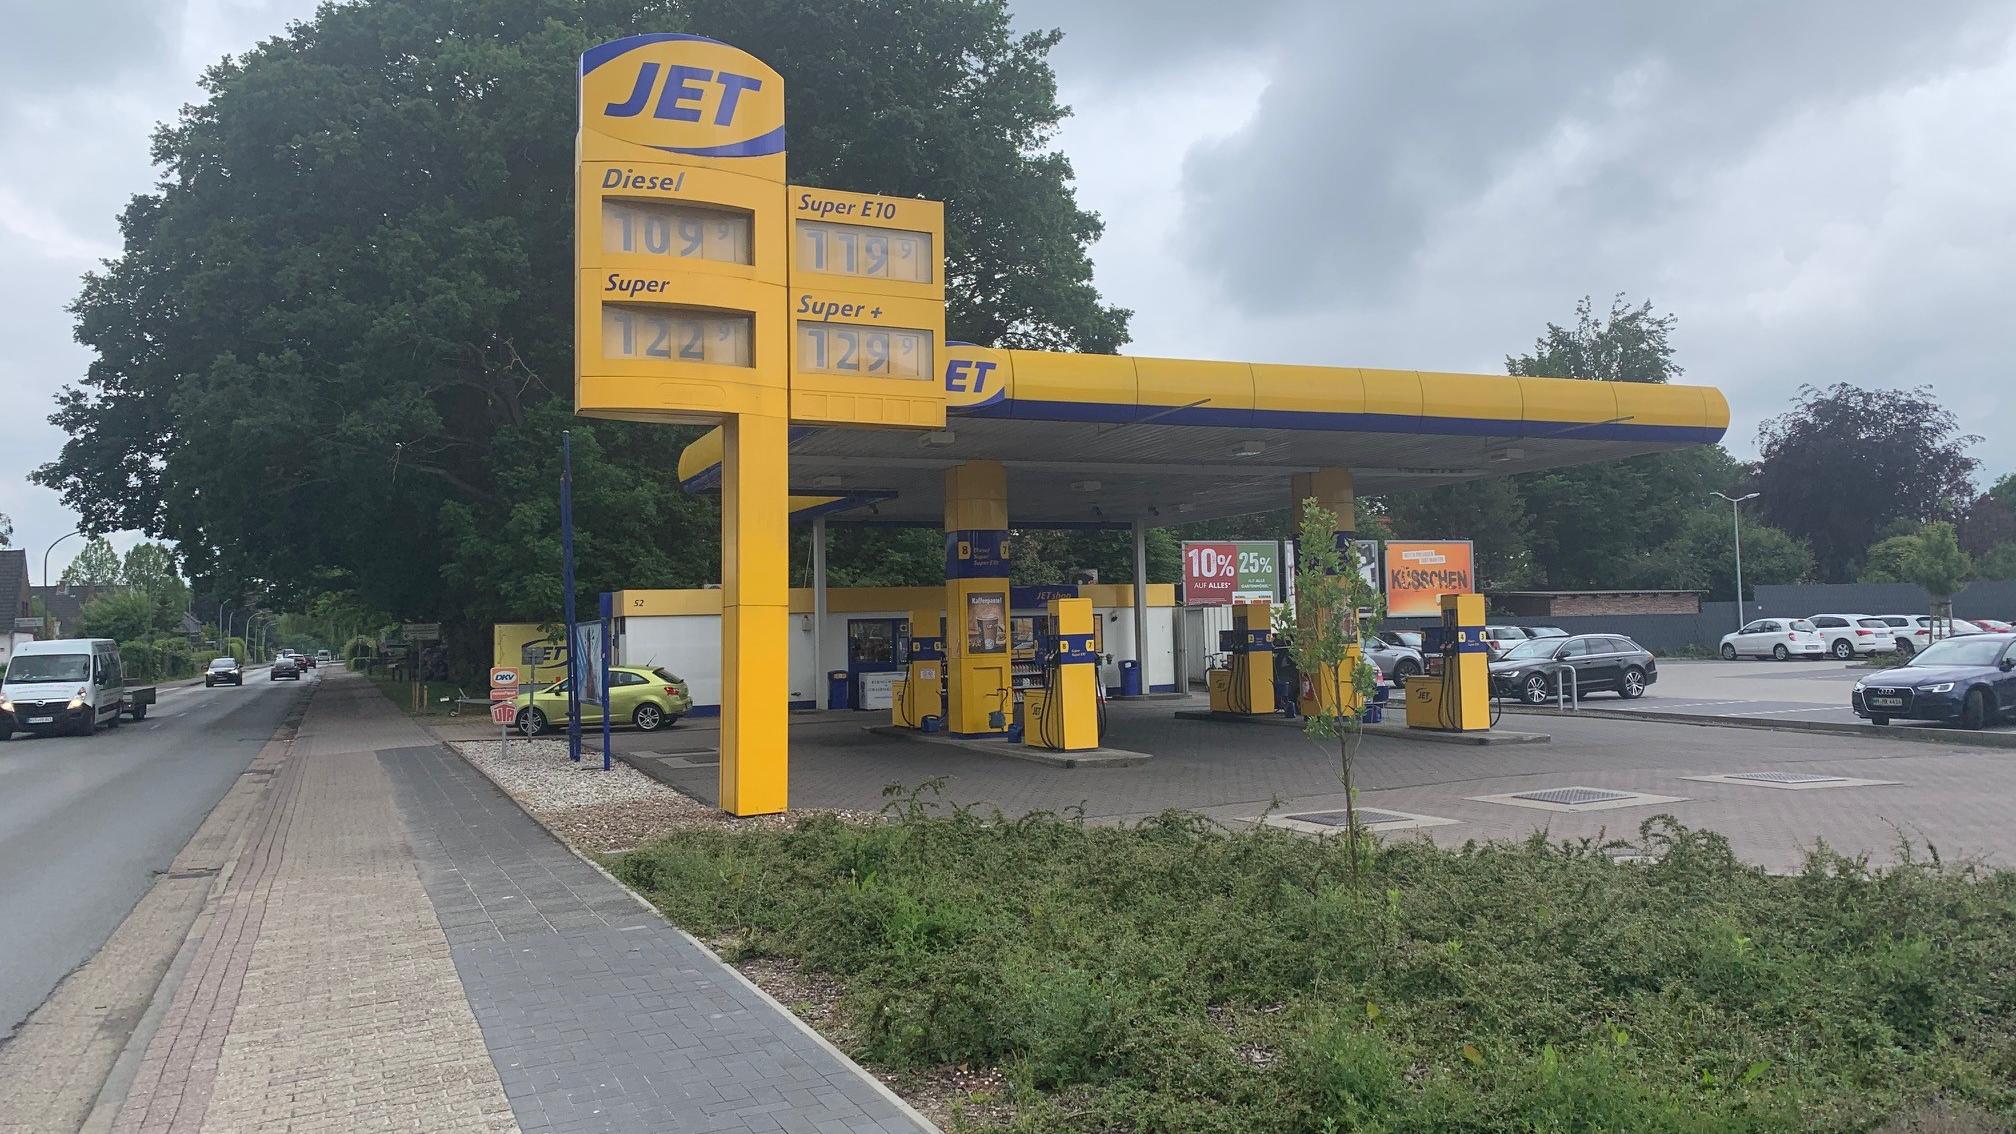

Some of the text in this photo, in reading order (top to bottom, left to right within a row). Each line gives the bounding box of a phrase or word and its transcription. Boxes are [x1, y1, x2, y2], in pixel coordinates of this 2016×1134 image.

[604, 61, 762, 127] JET
[602, 168, 685, 191] Diesel
[798, 193, 896, 219] Super E10
[614, 209, 703, 257] 109
[806, 231, 888, 274] 119
[605, 273, 670, 297] Super
[797, 294, 882, 321] Super +
[614, 311, 704, 359] 122
[808, 330, 890, 371] 129
[945, 359, 997, 393] ET
[962, 545, 968, 555] 8
[1002, 545, 1007, 554] 7
[1188, 548, 1235, 578] 10%
[1239, 552, 1272, 573] 25%
[1391, 566, 1468, 590] KÜSSCHEN
[543, 646, 567, 660] ET
[1418, 691, 1431, 699] JET
[494, 704, 516, 721] UTA
